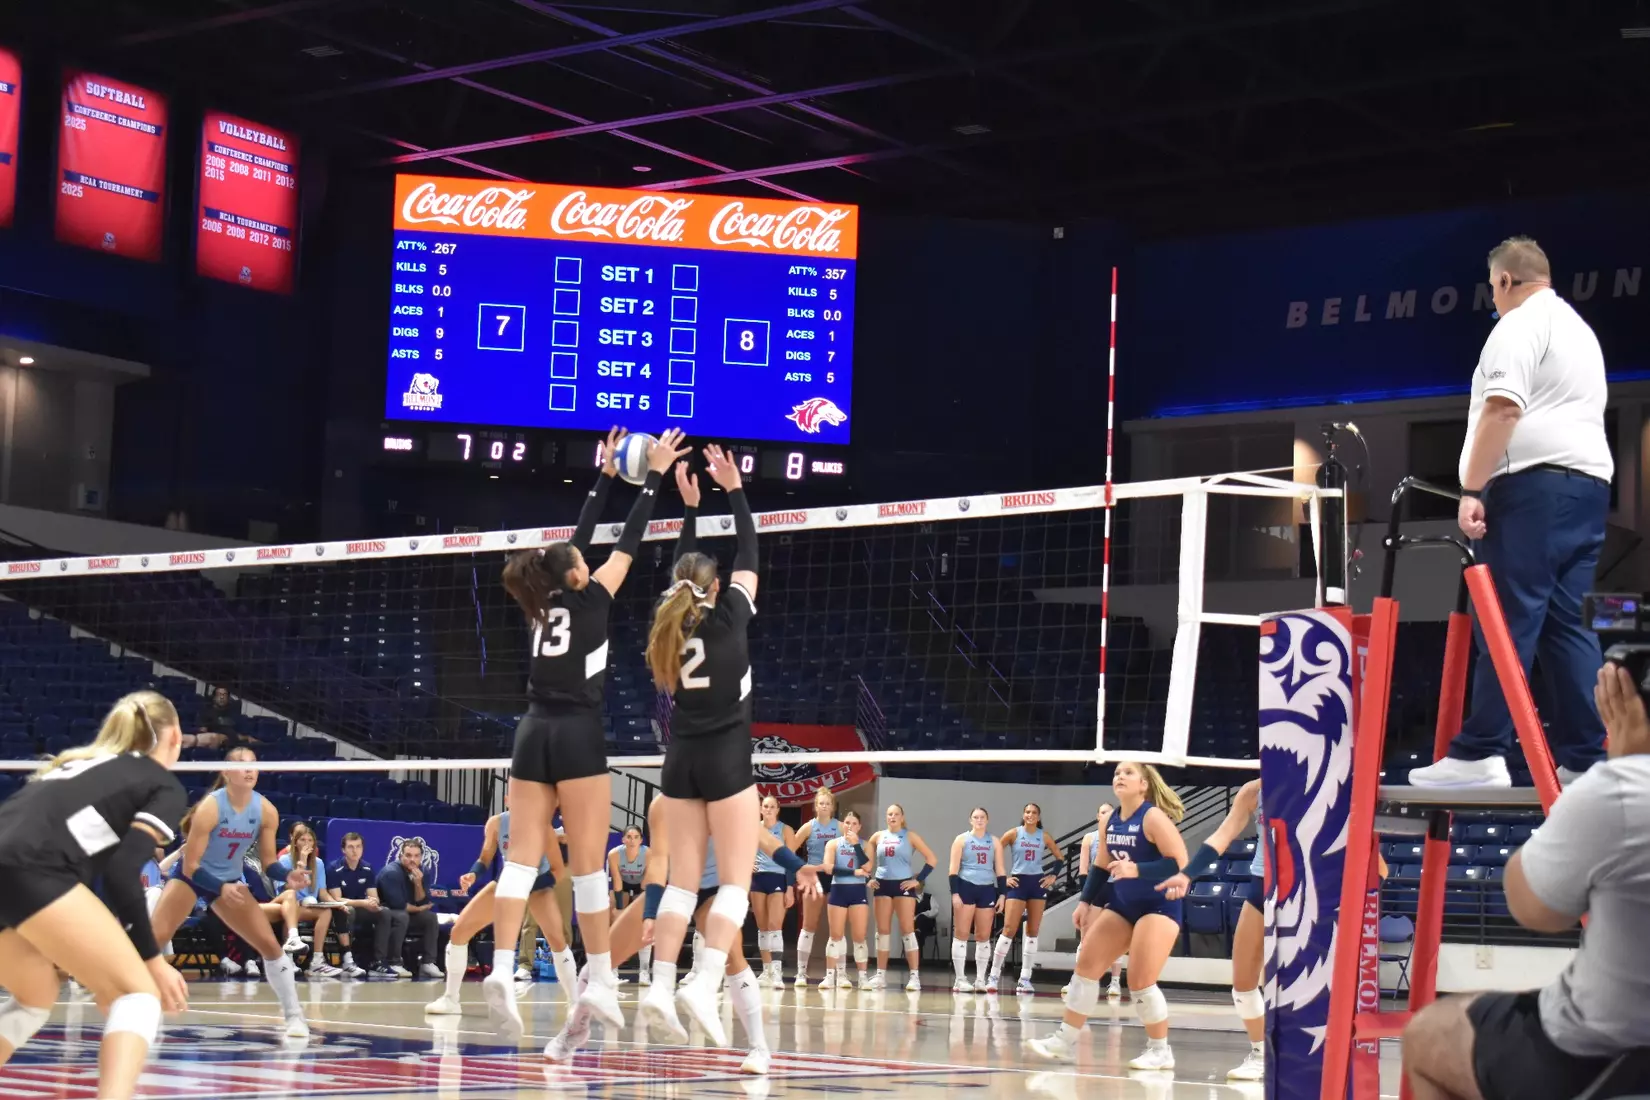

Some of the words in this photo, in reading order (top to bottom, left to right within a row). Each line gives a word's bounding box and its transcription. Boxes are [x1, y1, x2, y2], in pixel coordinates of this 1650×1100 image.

[86, 81, 146, 110] SOFTBALL
[64, 115, 86, 132] 2025
[74, 104, 117, 124] CONFERENCE
[118, 115, 156, 134] CHAMPIONS
[218, 120, 287, 151] VOLLEYBALL
[214, 145, 253, 164] CONFERENCE
[254, 156, 289, 173] CHAMPIONS
[205, 167, 225, 181] 2015
[206, 154, 225, 169] 2006
[229, 161, 249, 176] 2008
[252, 168, 272, 183] 2011
[276, 173, 295, 189] 2012
[61, 182, 83, 198] 2025
[79, 175, 98, 189] NCAA
[99, 180, 144, 198] TOURNAMENT
[219, 211, 236, 224] NCAA
[237, 215, 278, 234] TOURNAMENT
[402, 182, 536, 229] Coca-Cola
[550, 190, 694, 242] Coca-Cola
[709, 201, 850, 252] Coca-Cola
[202, 219, 222, 233] 2006
[249, 231, 269, 245] 2012
[272, 237, 291, 251] 2015
[397, 241, 427, 251] ATT%
[431, 243, 457, 255] .267
[396, 262, 427, 273] KILLS
[439, 264, 447, 275] 5
[601, 265, 640, 283] SET
[645, 268, 654, 283] 1
[788, 265, 817, 276] ATT%
[822, 268, 846, 280] .357
[395, 284, 423, 294] BLKS
[432, 285, 452, 297] 0.0
[788, 287, 817, 297] KILLS
[829, 289, 837, 300] 5
[393, 305, 423, 316] ACES
[437, 306, 444, 317] 1
[600, 297, 639, 314] SET
[642, 300, 654, 315] 2
[787, 308, 815, 318] BLKS
[823, 310, 842, 321] 0.0
[1286, 283, 1495, 329] BELMON
[393, 327, 419, 337] DIGS
[435, 327, 444, 339] 9
[496, 316, 511, 336] 7
[598, 329, 637, 346] SET
[641, 332, 653, 347] 3
[740, 330, 754, 351] 8
[786, 330, 815, 340] ACES
[828, 331, 835, 342] 1
[391, 348, 420, 359] ASTS
[435, 349, 443, 360] 5
[785, 351, 811, 361] DIGS
[827, 351, 835, 362] 7
[597, 360, 636, 377] SET
[640, 363, 651, 379] 4
[784, 372, 812, 382] ASTS
[826, 372, 834, 383] 5
[595, 392, 634, 409] SET
[638, 395, 650, 410] 5
[457, 434, 471, 460] 7
[491, 441, 503, 460] 0
[513, 442, 525, 461] 2
[741, 455, 753, 473] 0
[786, 452, 804, 480] 8
[8, 562, 40, 573] BRUINS
[88, 558, 120, 569] BELMONT
[169, 553, 205, 565] BRUINS
[257, 548, 292, 560] BELMONT
[346, 540, 385, 554] BRUINS
[443, 535, 482, 548] BELMONT
[542, 528, 577, 541] BRUI
[758, 512, 807, 527] BRUINS
[878, 502, 926, 518] BELMONT
[1001, 492, 1056, 509] BRUINS
[532, 607, 570, 657] 13
[680, 637, 710, 689] 2
[228, 842, 240, 859] 7
[885, 846, 895, 857] 16
[976, 852, 987, 864] 13
[1025, 850, 1035, 861] 21
[1356, 891, 1378, 1054] BELMOT
